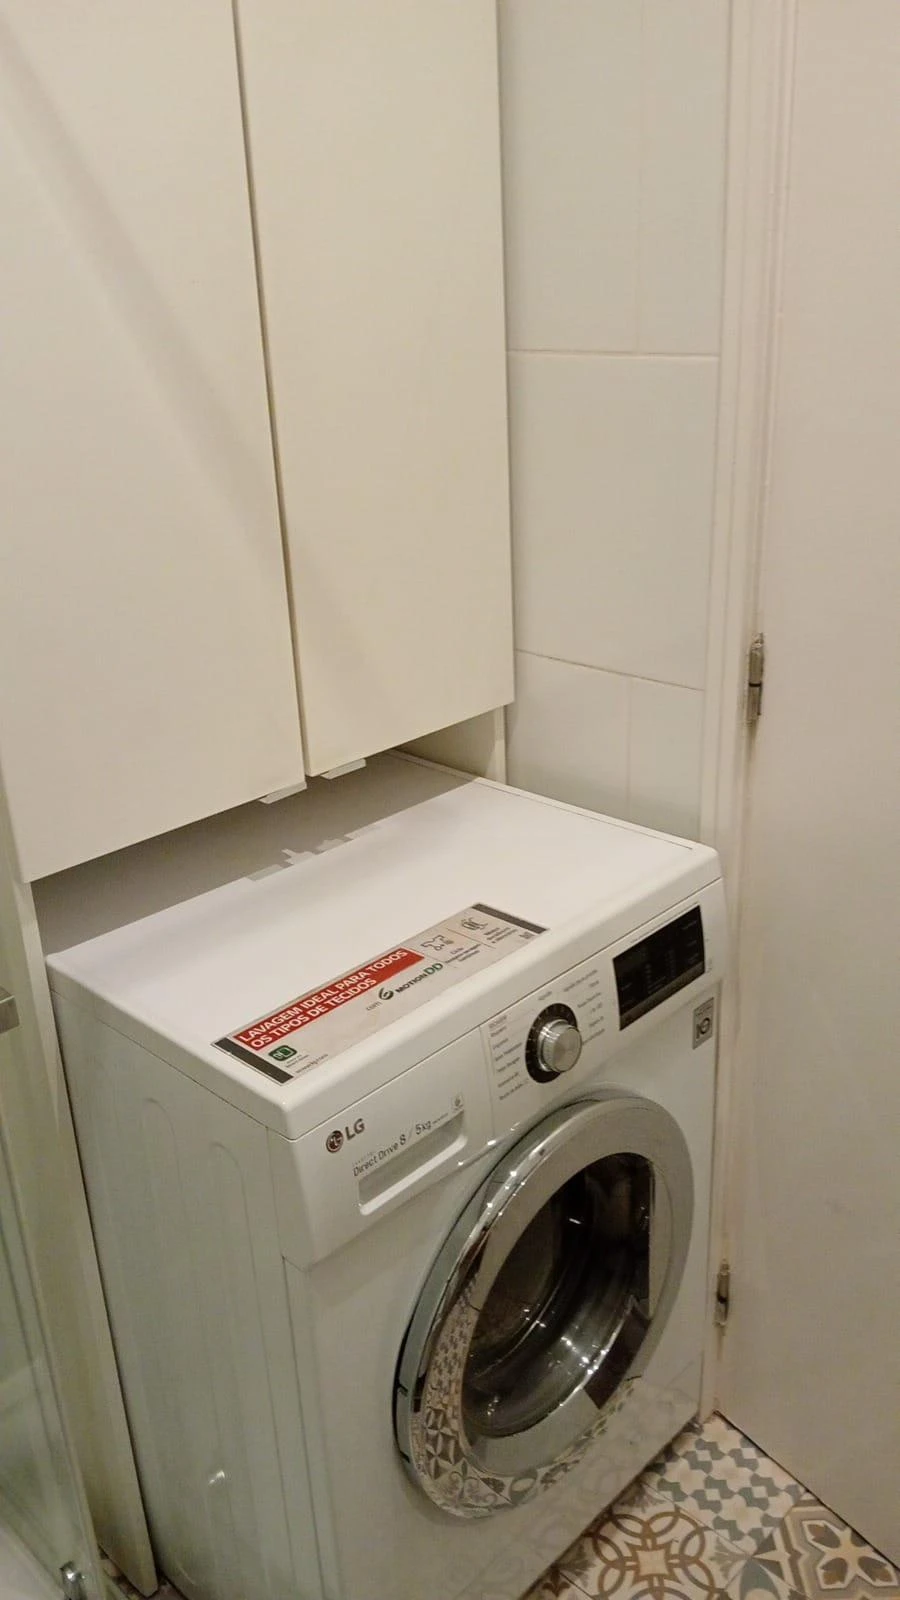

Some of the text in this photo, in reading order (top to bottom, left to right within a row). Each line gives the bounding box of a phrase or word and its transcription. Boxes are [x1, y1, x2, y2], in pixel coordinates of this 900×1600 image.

[239, 949, 409, 1042] LAVAGEM IDEAL PARA TODOS
[250, 977, 377, 1050] OS TIPOS DE TECIDOS
[345, 1118, 365, 1141] LG
[353, 1157, 378, 1177] Direct
[378, 1142, 399, 1160] Drive
